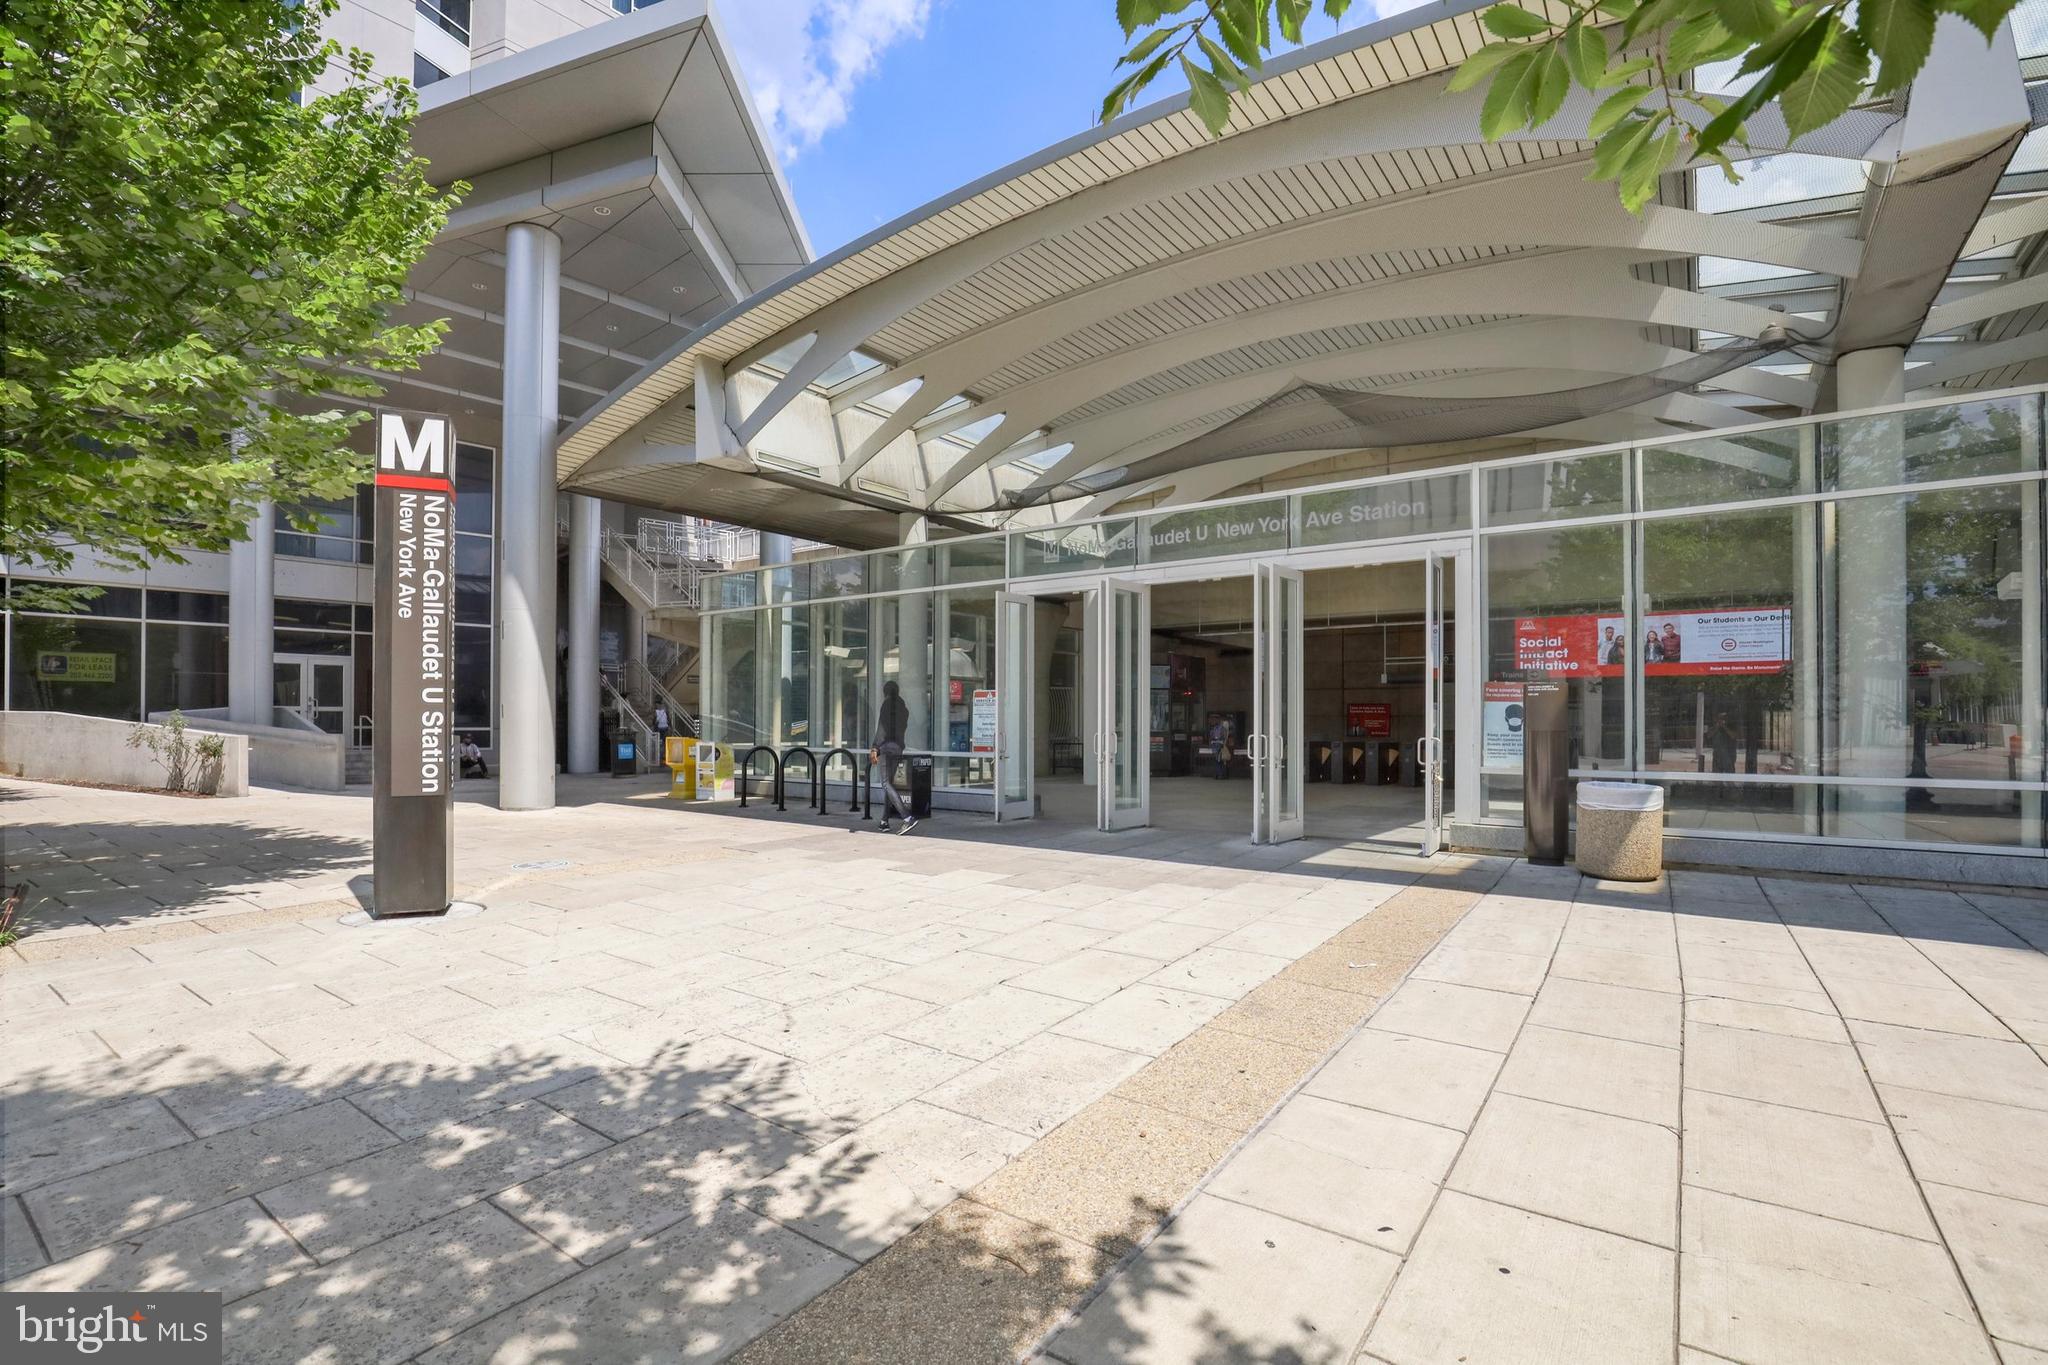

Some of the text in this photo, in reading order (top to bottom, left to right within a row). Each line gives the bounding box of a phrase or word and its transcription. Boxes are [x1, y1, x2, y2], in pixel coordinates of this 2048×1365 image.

[381, 414, 444, 473] M
[398, 493, 417, 618] New York Ave
[1067, 528, 1191, 556] NoMGaaudet
[1196, 524, 1207, 541] U
[1216, 522, 1254, 539] New
[1305, 511, 1343, 528] Ave
[1350, 500, 1425, 523] Station
[421, 496, 446, 792] NoMa-Gallaudet U Station
[1519, 636, 1562, 647] Social
[1713, 616, 1745, 624] Students
[1519, 659, 1579, 670] Initiative
